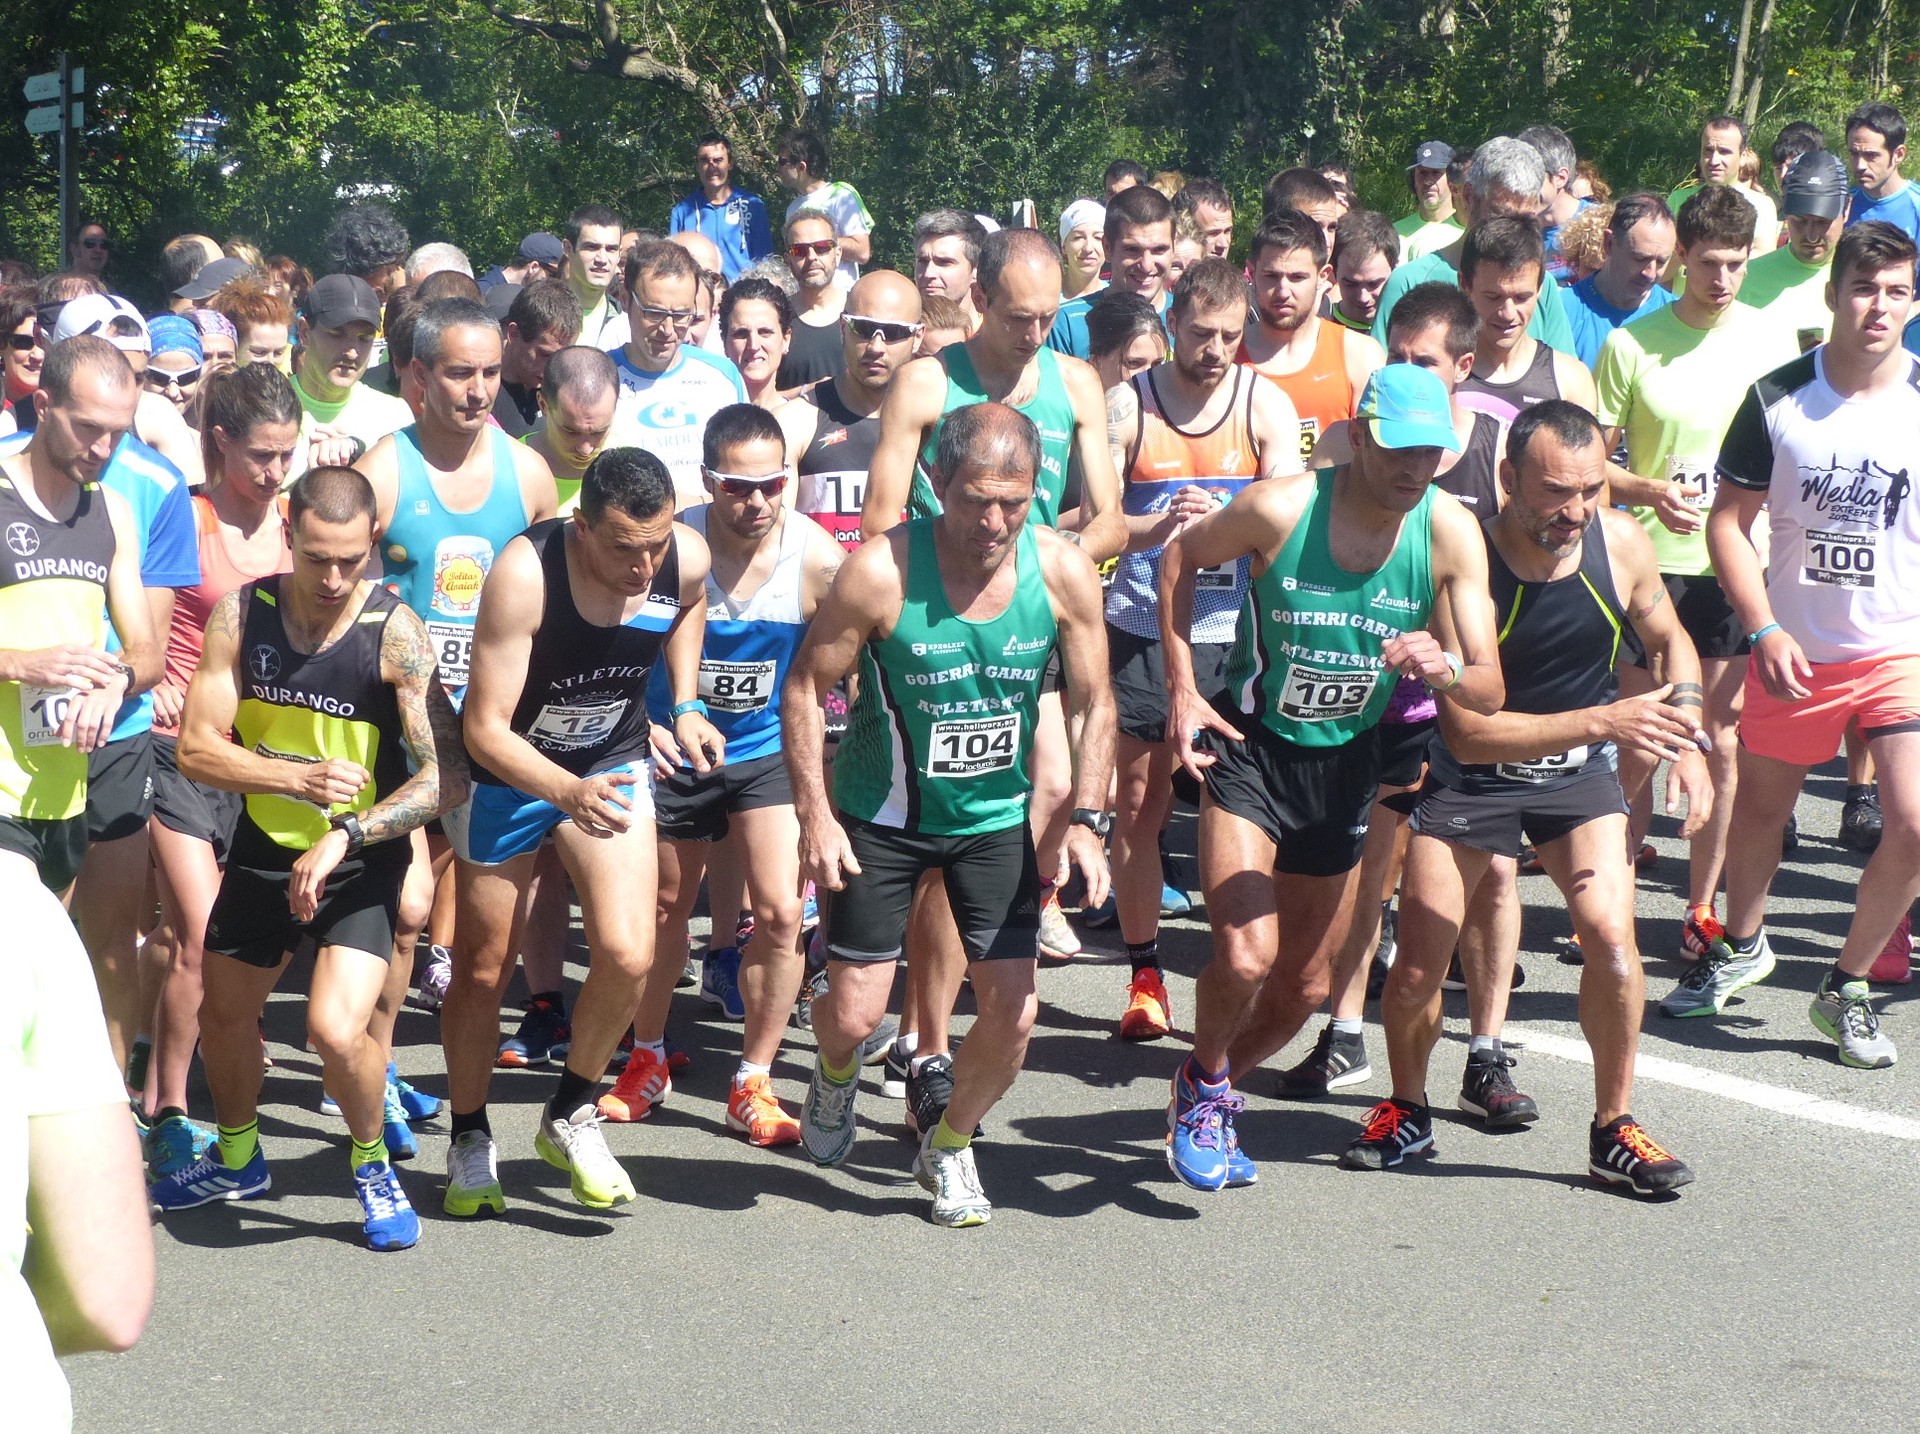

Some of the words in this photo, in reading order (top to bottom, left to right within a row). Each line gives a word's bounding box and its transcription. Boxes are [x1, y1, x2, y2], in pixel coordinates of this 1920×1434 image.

[1801, 473, 1882, 511] Media
[1831, 505, 1877, 518] EXTREME
[15, 558, 108, 583] DURANGO
[1810, 544, 1875, 572] 100
[1272, 610, 1346, 626] GOIERRI
[1350, 614, 1406, 639] GARA
[713, 675, 758, 697] 84
[905, 662, 980, 685] GOIERRI
[252, 685, 355, 717] DURANGO
[917, 691, 1024, 716] ATLETISMO
[1296, 682, 1368, 706] 103
[561, 716, 607, 733] 12
[941, 730, 1013, 759] 104
